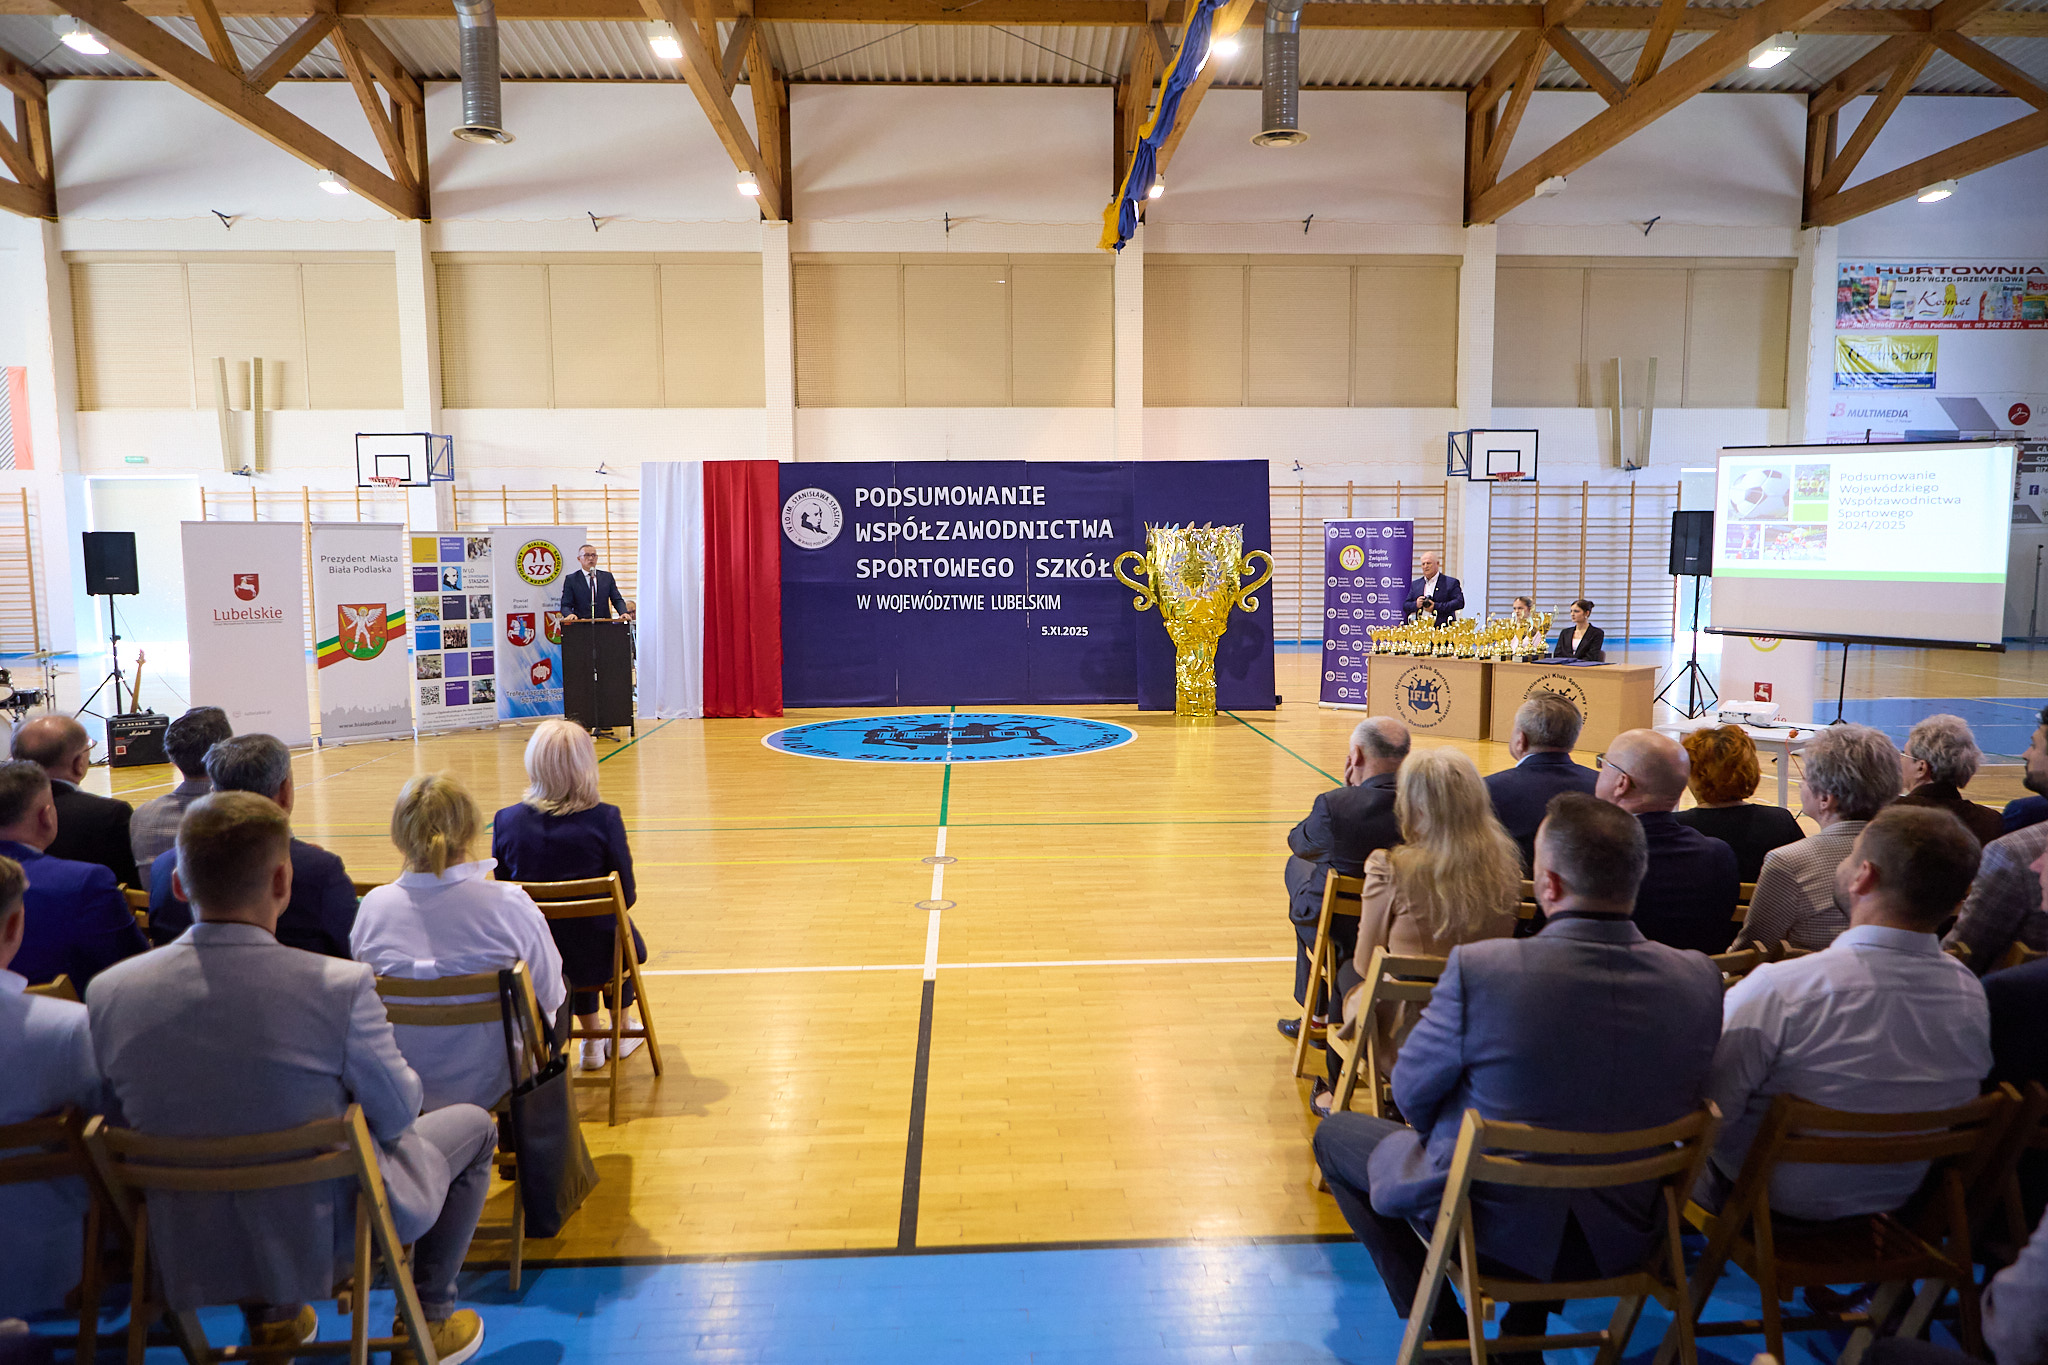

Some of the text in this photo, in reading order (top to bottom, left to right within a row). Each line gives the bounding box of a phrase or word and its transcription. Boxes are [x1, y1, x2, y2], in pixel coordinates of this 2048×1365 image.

[1875, 266, 2045, 275] HURTOWNIA
[1847, 408, 1909, 418] MULTIMEDIA
[1840, 471, 1936, 481] Podsumowanie
[1840, 484, 1939, 495] Wojewódzkiego
[855, 485, 1046, 507] PODSUMOWANIE
[1839, 496, 1961, 507] Współzawodnictwa
[784, 516, 791, 525] LO
[791, 491, 830, 505] STANISŁAWA
[828, 500, 840, 528] STASZICA
[1838, 508, 1914, 519] Sportowego
[855, 515, 1114, 542] WSPÓŁZAWODNICTWA
[1837, 520, 1906, 530] 2024/2025
[320, 555, 366, 564] Prezydent
[329, 565, 392, 574] Biała Podlaska
[527, 564, 552, 576] SZS
[856, 552, 1113, 579] SPORTOWEGO SZKÓŁ
[856, 590, 1061, 613] W WOJEWÓDZTWIE LUBELSKIM
[213, 606, 283, 620] Lubelskie
[1041, 626, 1089, 637] 5.XI.2025
[1433, 669, 1450, 694] Sportowy
[1552, 673, 1567, 681] Klub
[1568, 677, 1587, 705] Sportowy
